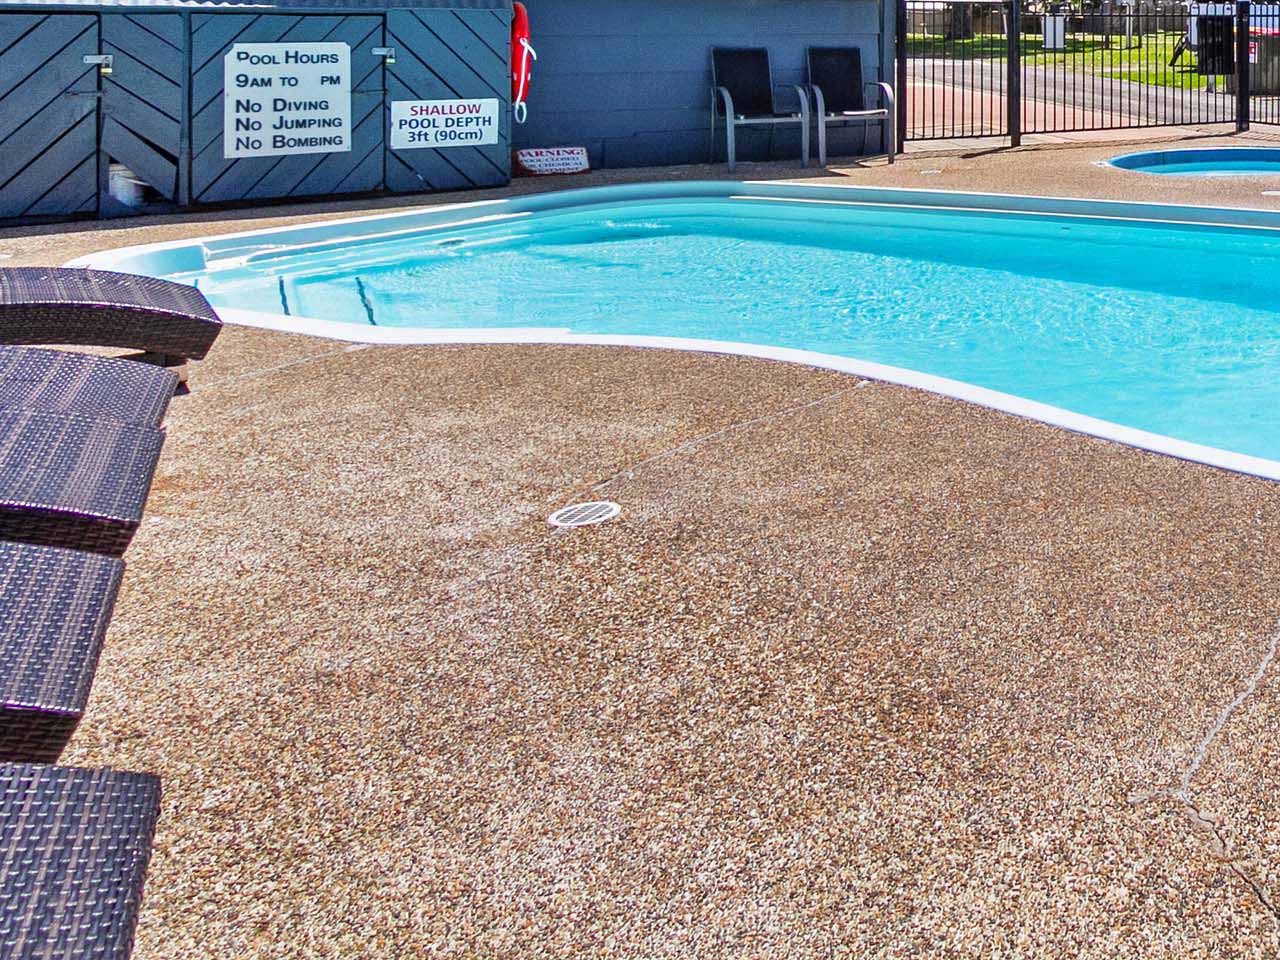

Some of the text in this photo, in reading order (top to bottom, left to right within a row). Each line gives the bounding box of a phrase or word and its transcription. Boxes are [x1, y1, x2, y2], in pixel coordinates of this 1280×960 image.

[236, 51, 339, 65] POOL HOURS
[235, 74, 340, 87] 9AM TO PM
[273, 98, 329, 112] DIVING
[410, 104, 481, 116] SHALLOW
[272, 116, 342, 130] JUMPING
[399, 116, 491, 129] POOL DEPTH
[272, 135, 343, 149] BOMBING
[408, 129, 483, 143] 3ft (90cm)
